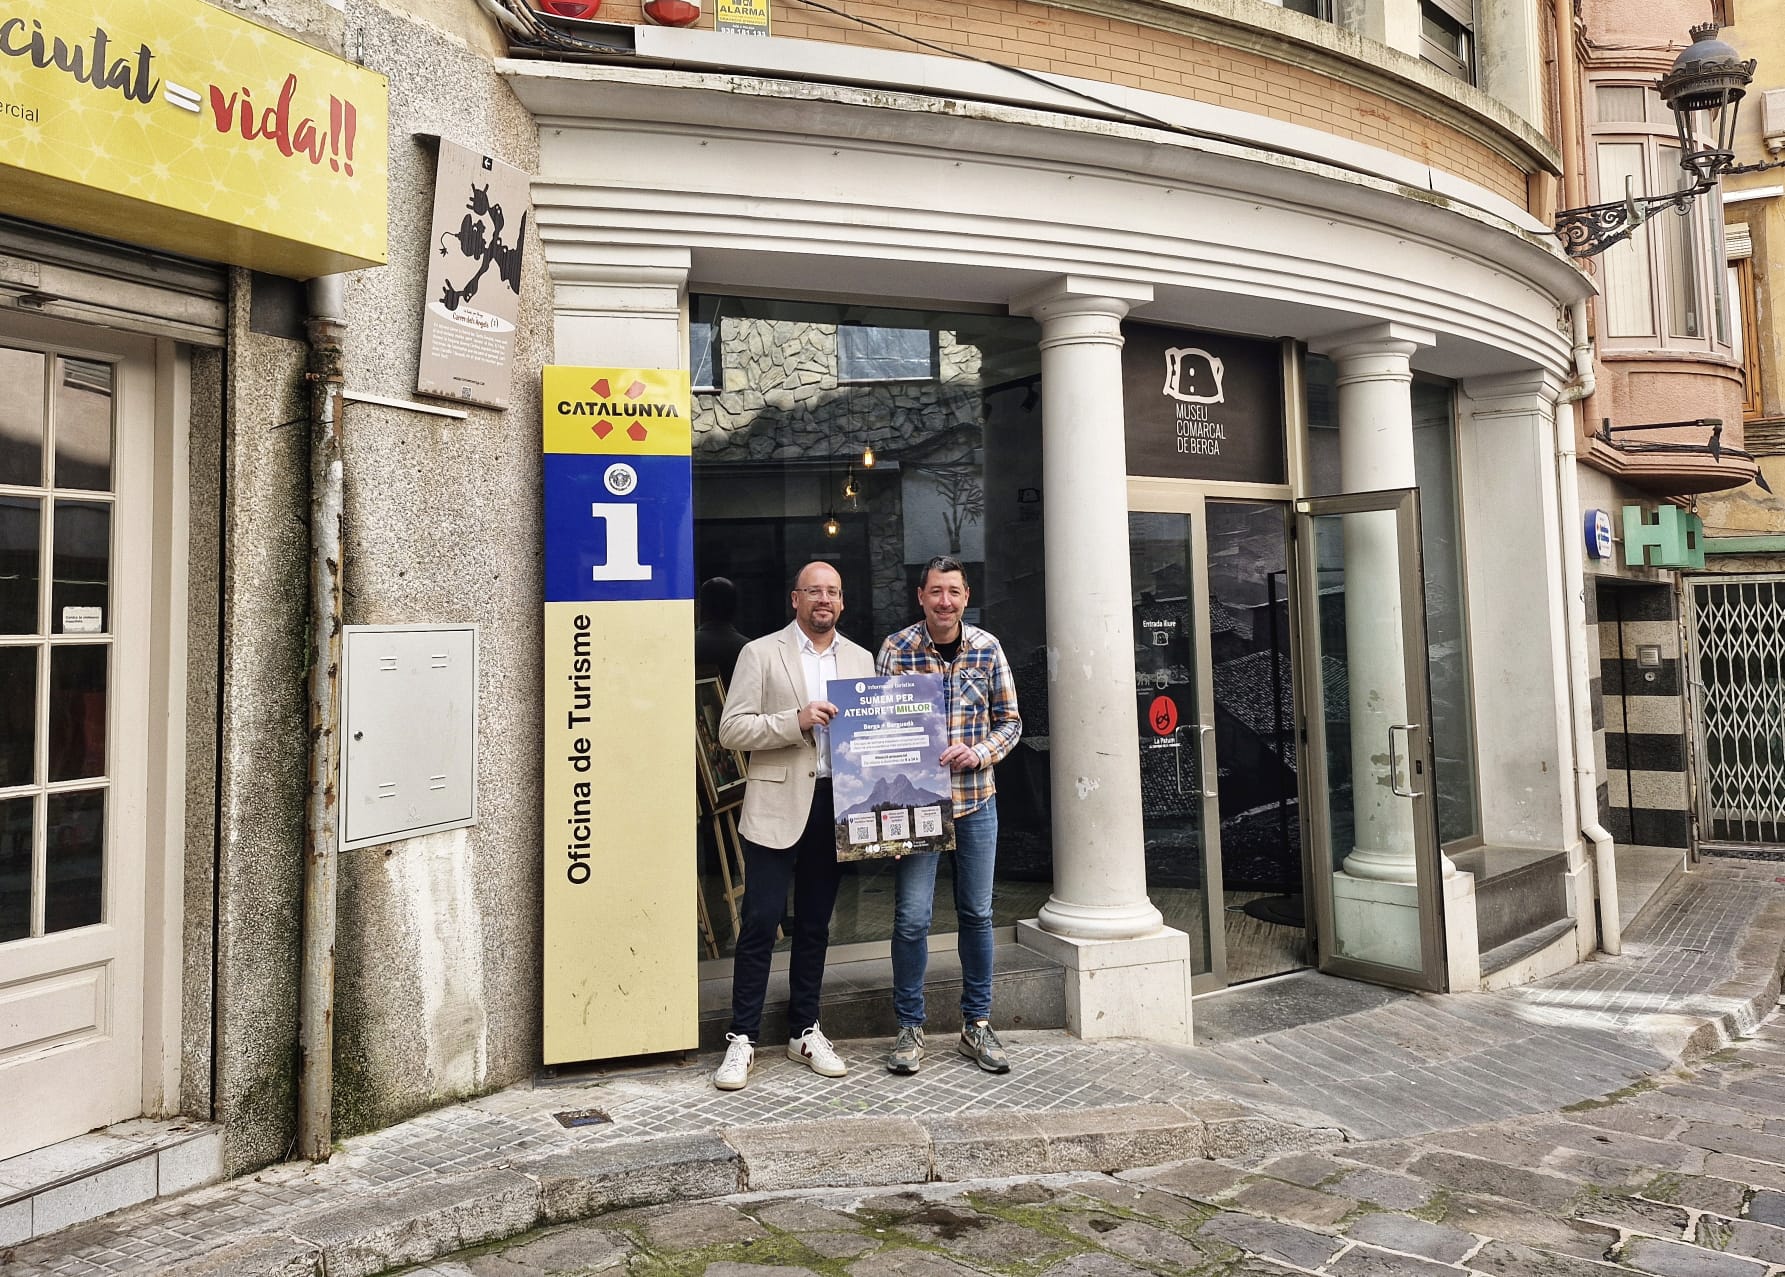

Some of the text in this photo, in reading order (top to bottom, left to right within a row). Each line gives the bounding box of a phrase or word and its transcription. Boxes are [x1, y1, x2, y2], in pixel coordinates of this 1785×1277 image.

[720, 5, 765, 16] ALARMA
[0, 17, 161, 105] ciutat
[209, 72, 357, 178] vida!!
[557, 400, 679, 418] CATALUNYA
[1176, 403, 1208, 421] MUSEU
[1176, 420, 1227, 440] COMARCAL
[1177, 437, 1220, 455] DE BERGA
[1142, 619, 1163, 628] Entrada
[859, 693, 914, 705] SUMEM PER
[844, 703, 931, 718] ATENDRE'T MILLOR
[567, 614, 591, 885] Oficina de Turisme
